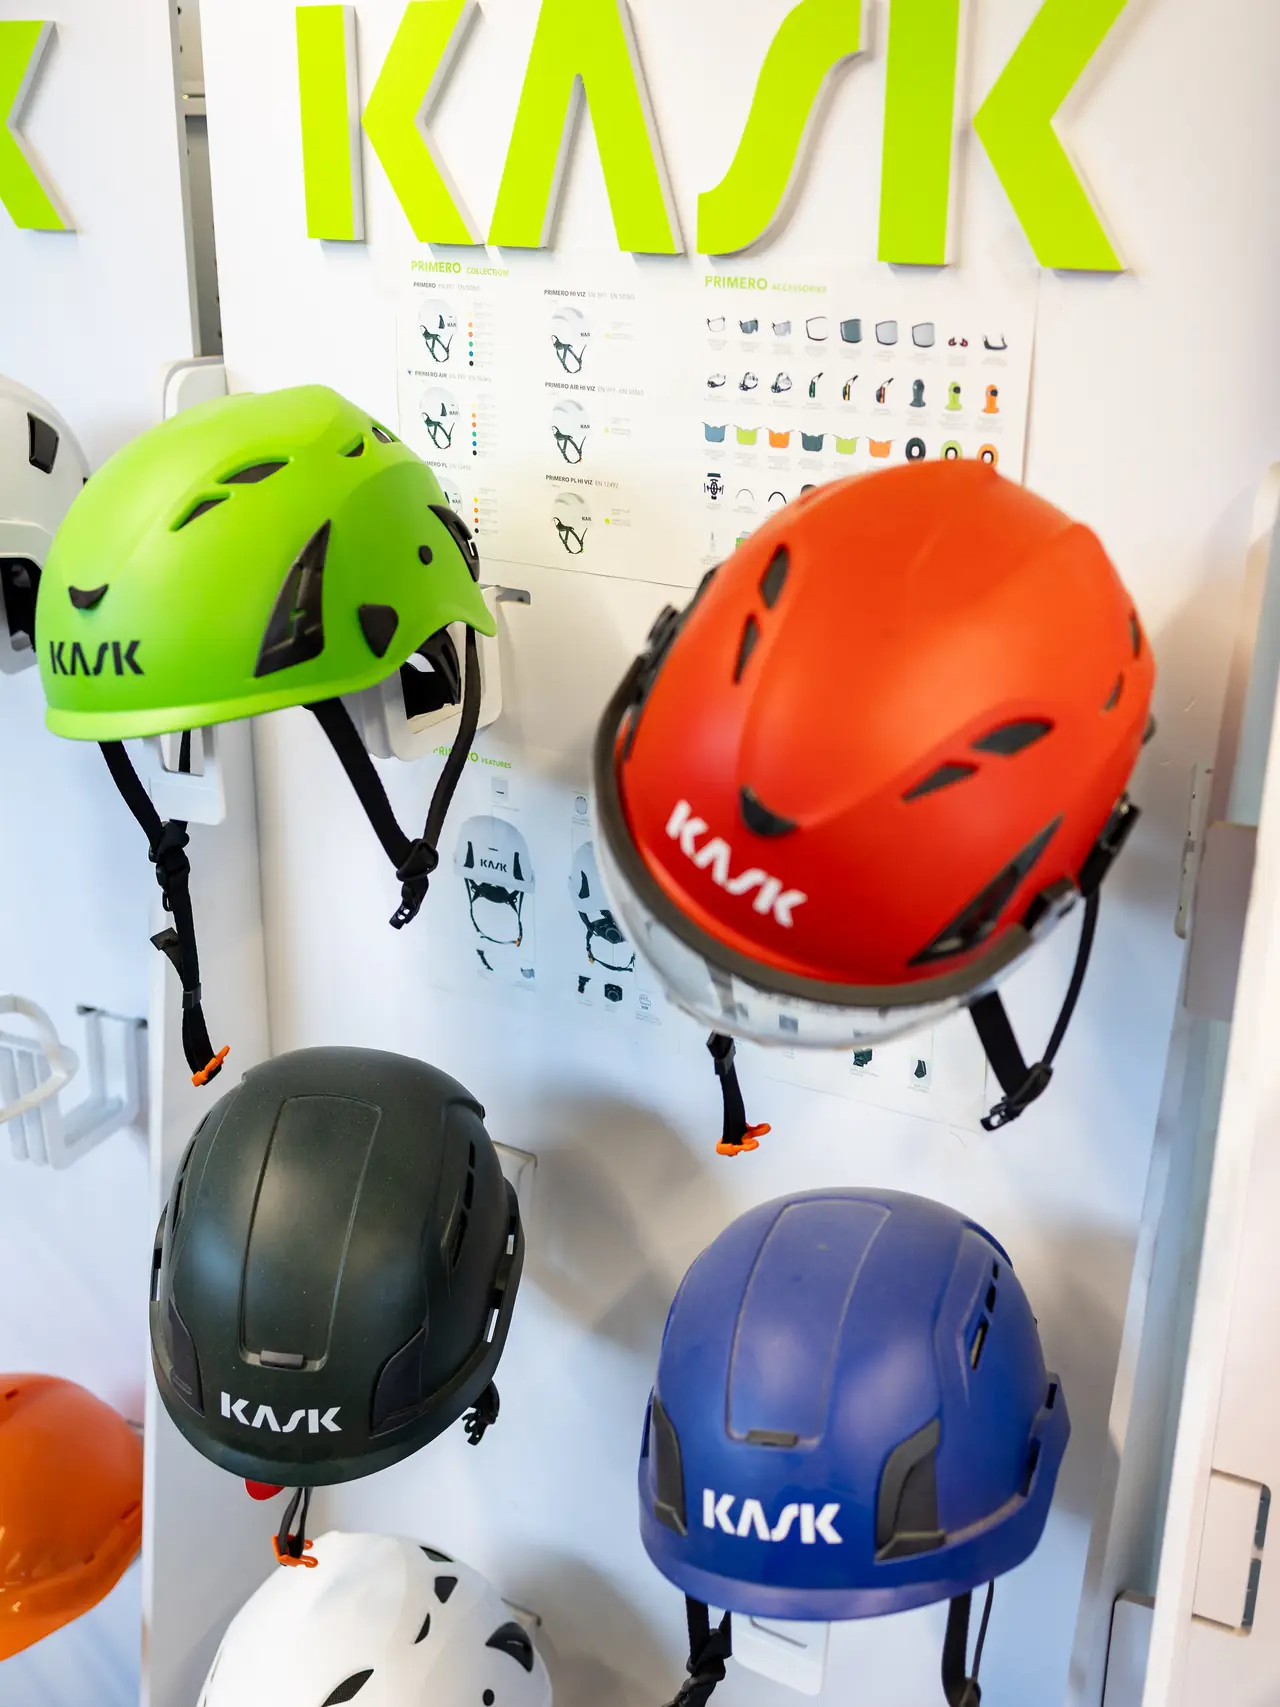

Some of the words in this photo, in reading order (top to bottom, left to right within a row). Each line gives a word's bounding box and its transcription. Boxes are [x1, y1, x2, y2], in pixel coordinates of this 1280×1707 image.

[296, 0, 1128, 272] KASK
[411, 260, 462, 274] PRIMERO
[466, 267, 509, 277] COLLECTION
[413, 281, 436, 289] PRIMERO
[705, 275, 768, 290] PRIMERO
[771, 283, 827, 293] ACCESSORIES
[544, 381, 569, 389] PRIMERO
[545, 474, 570, 482] PRIMERO
[49, 639, 145, 676] KASK
[481, 757, 512, 769] FEATURES
[480, 858, 507, 872] KASK
[665, 798, 808, 929] KASK
[221, 1391, 342, 1433] KASK
[702, 1487, 843, 1544] KASK
